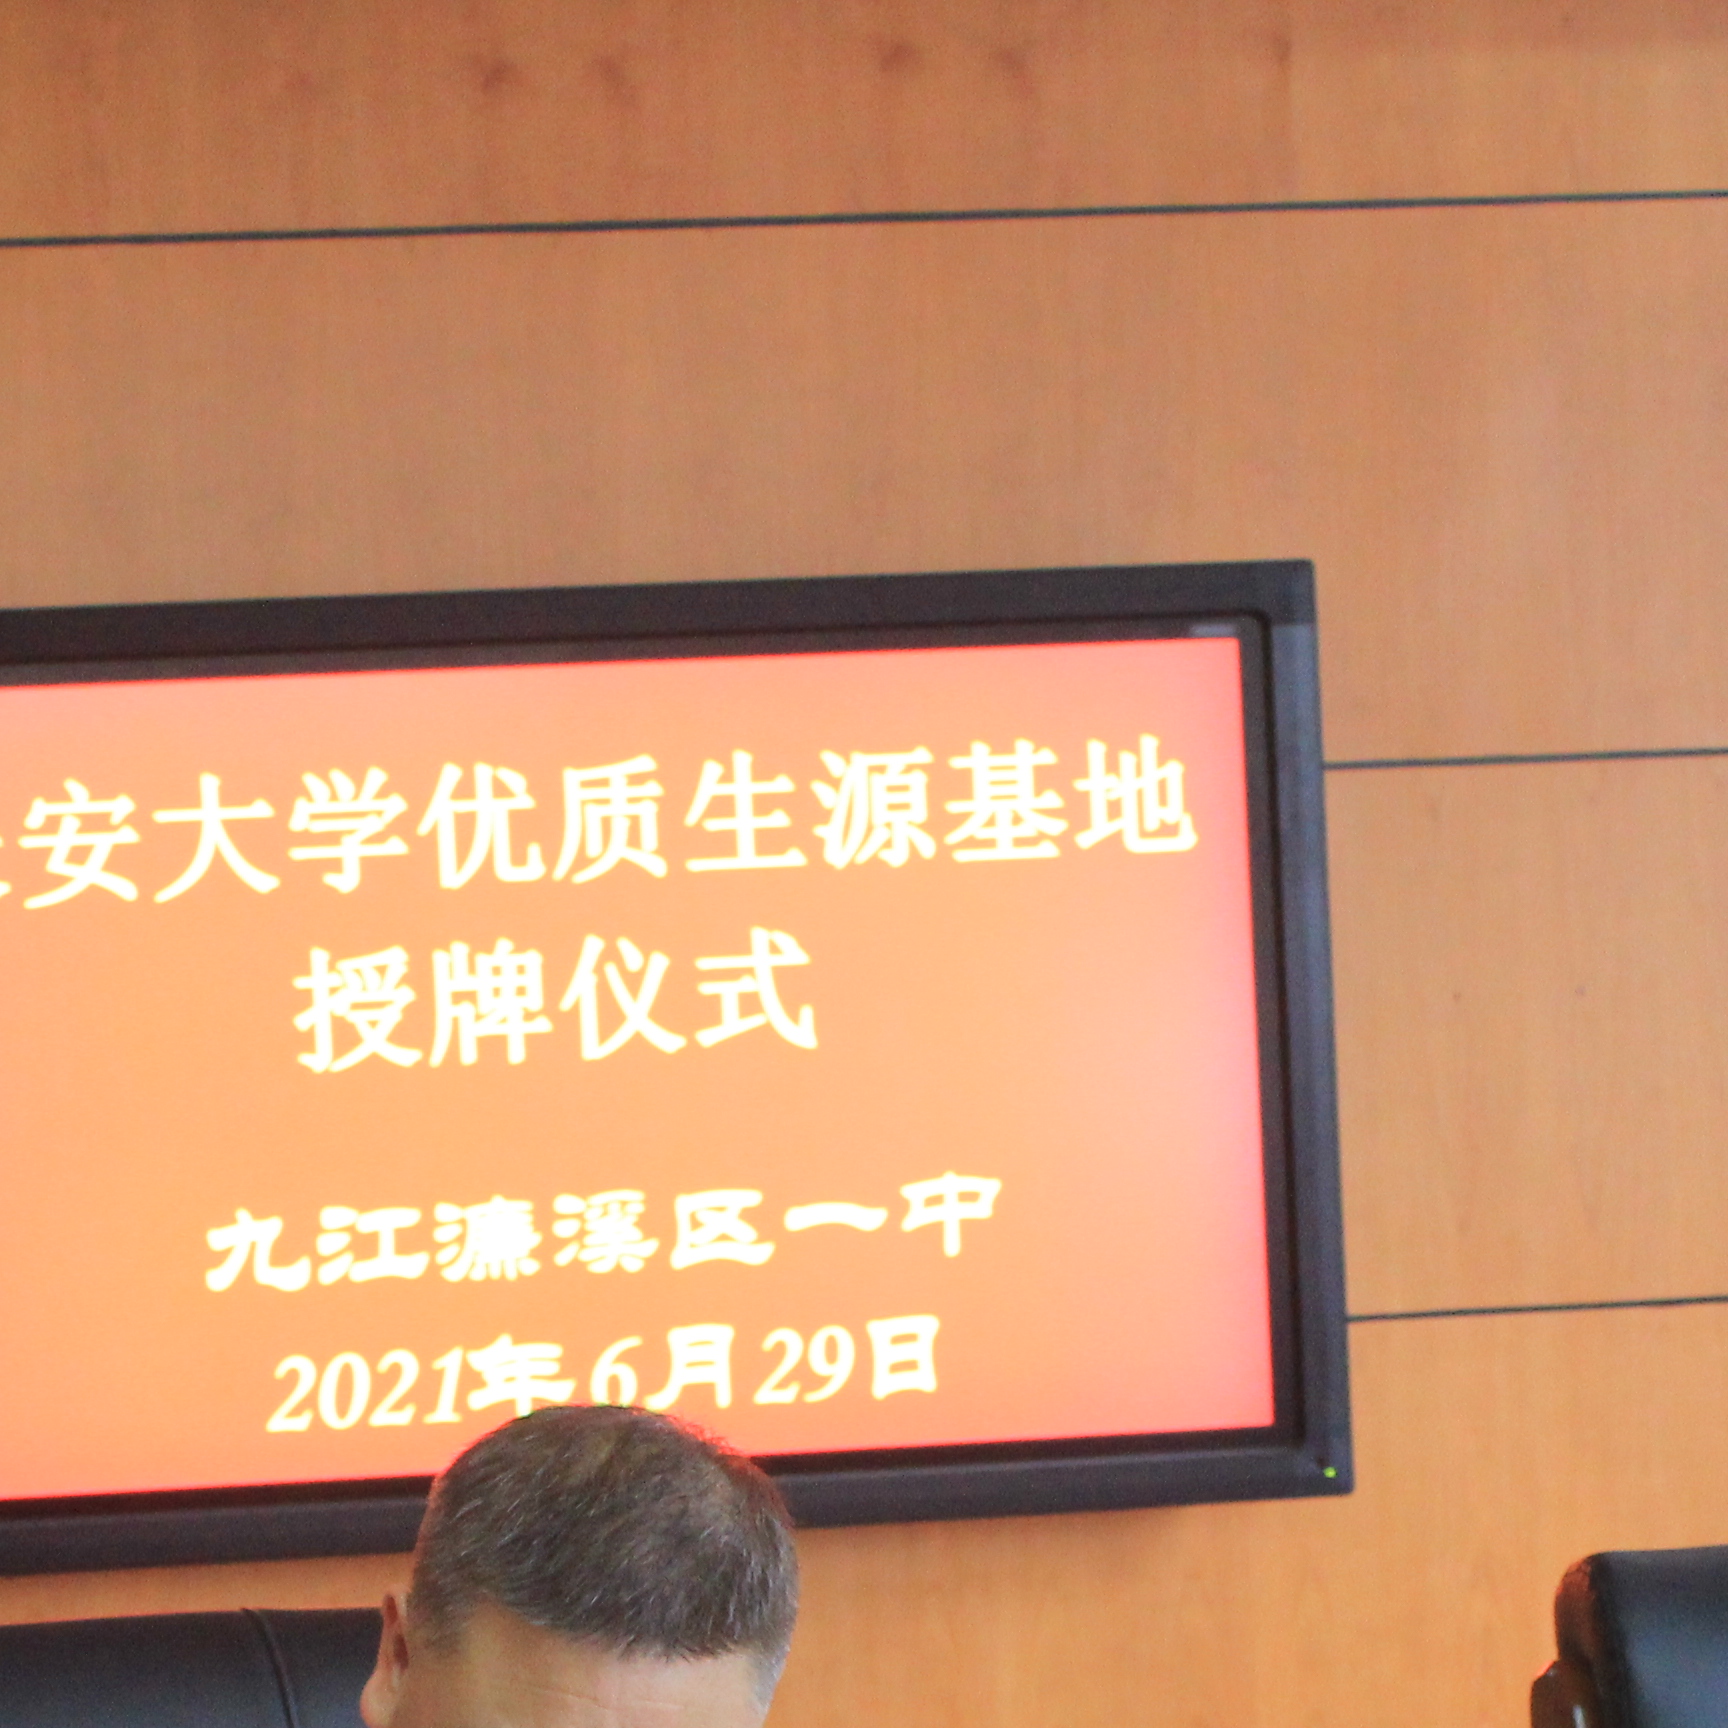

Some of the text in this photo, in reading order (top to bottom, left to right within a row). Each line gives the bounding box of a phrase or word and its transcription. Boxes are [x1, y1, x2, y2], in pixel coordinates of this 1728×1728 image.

[291, 925, 819, 1073] 授牌仪式
[205, 1171, 1003, 1292] 九江濂溪区一中
